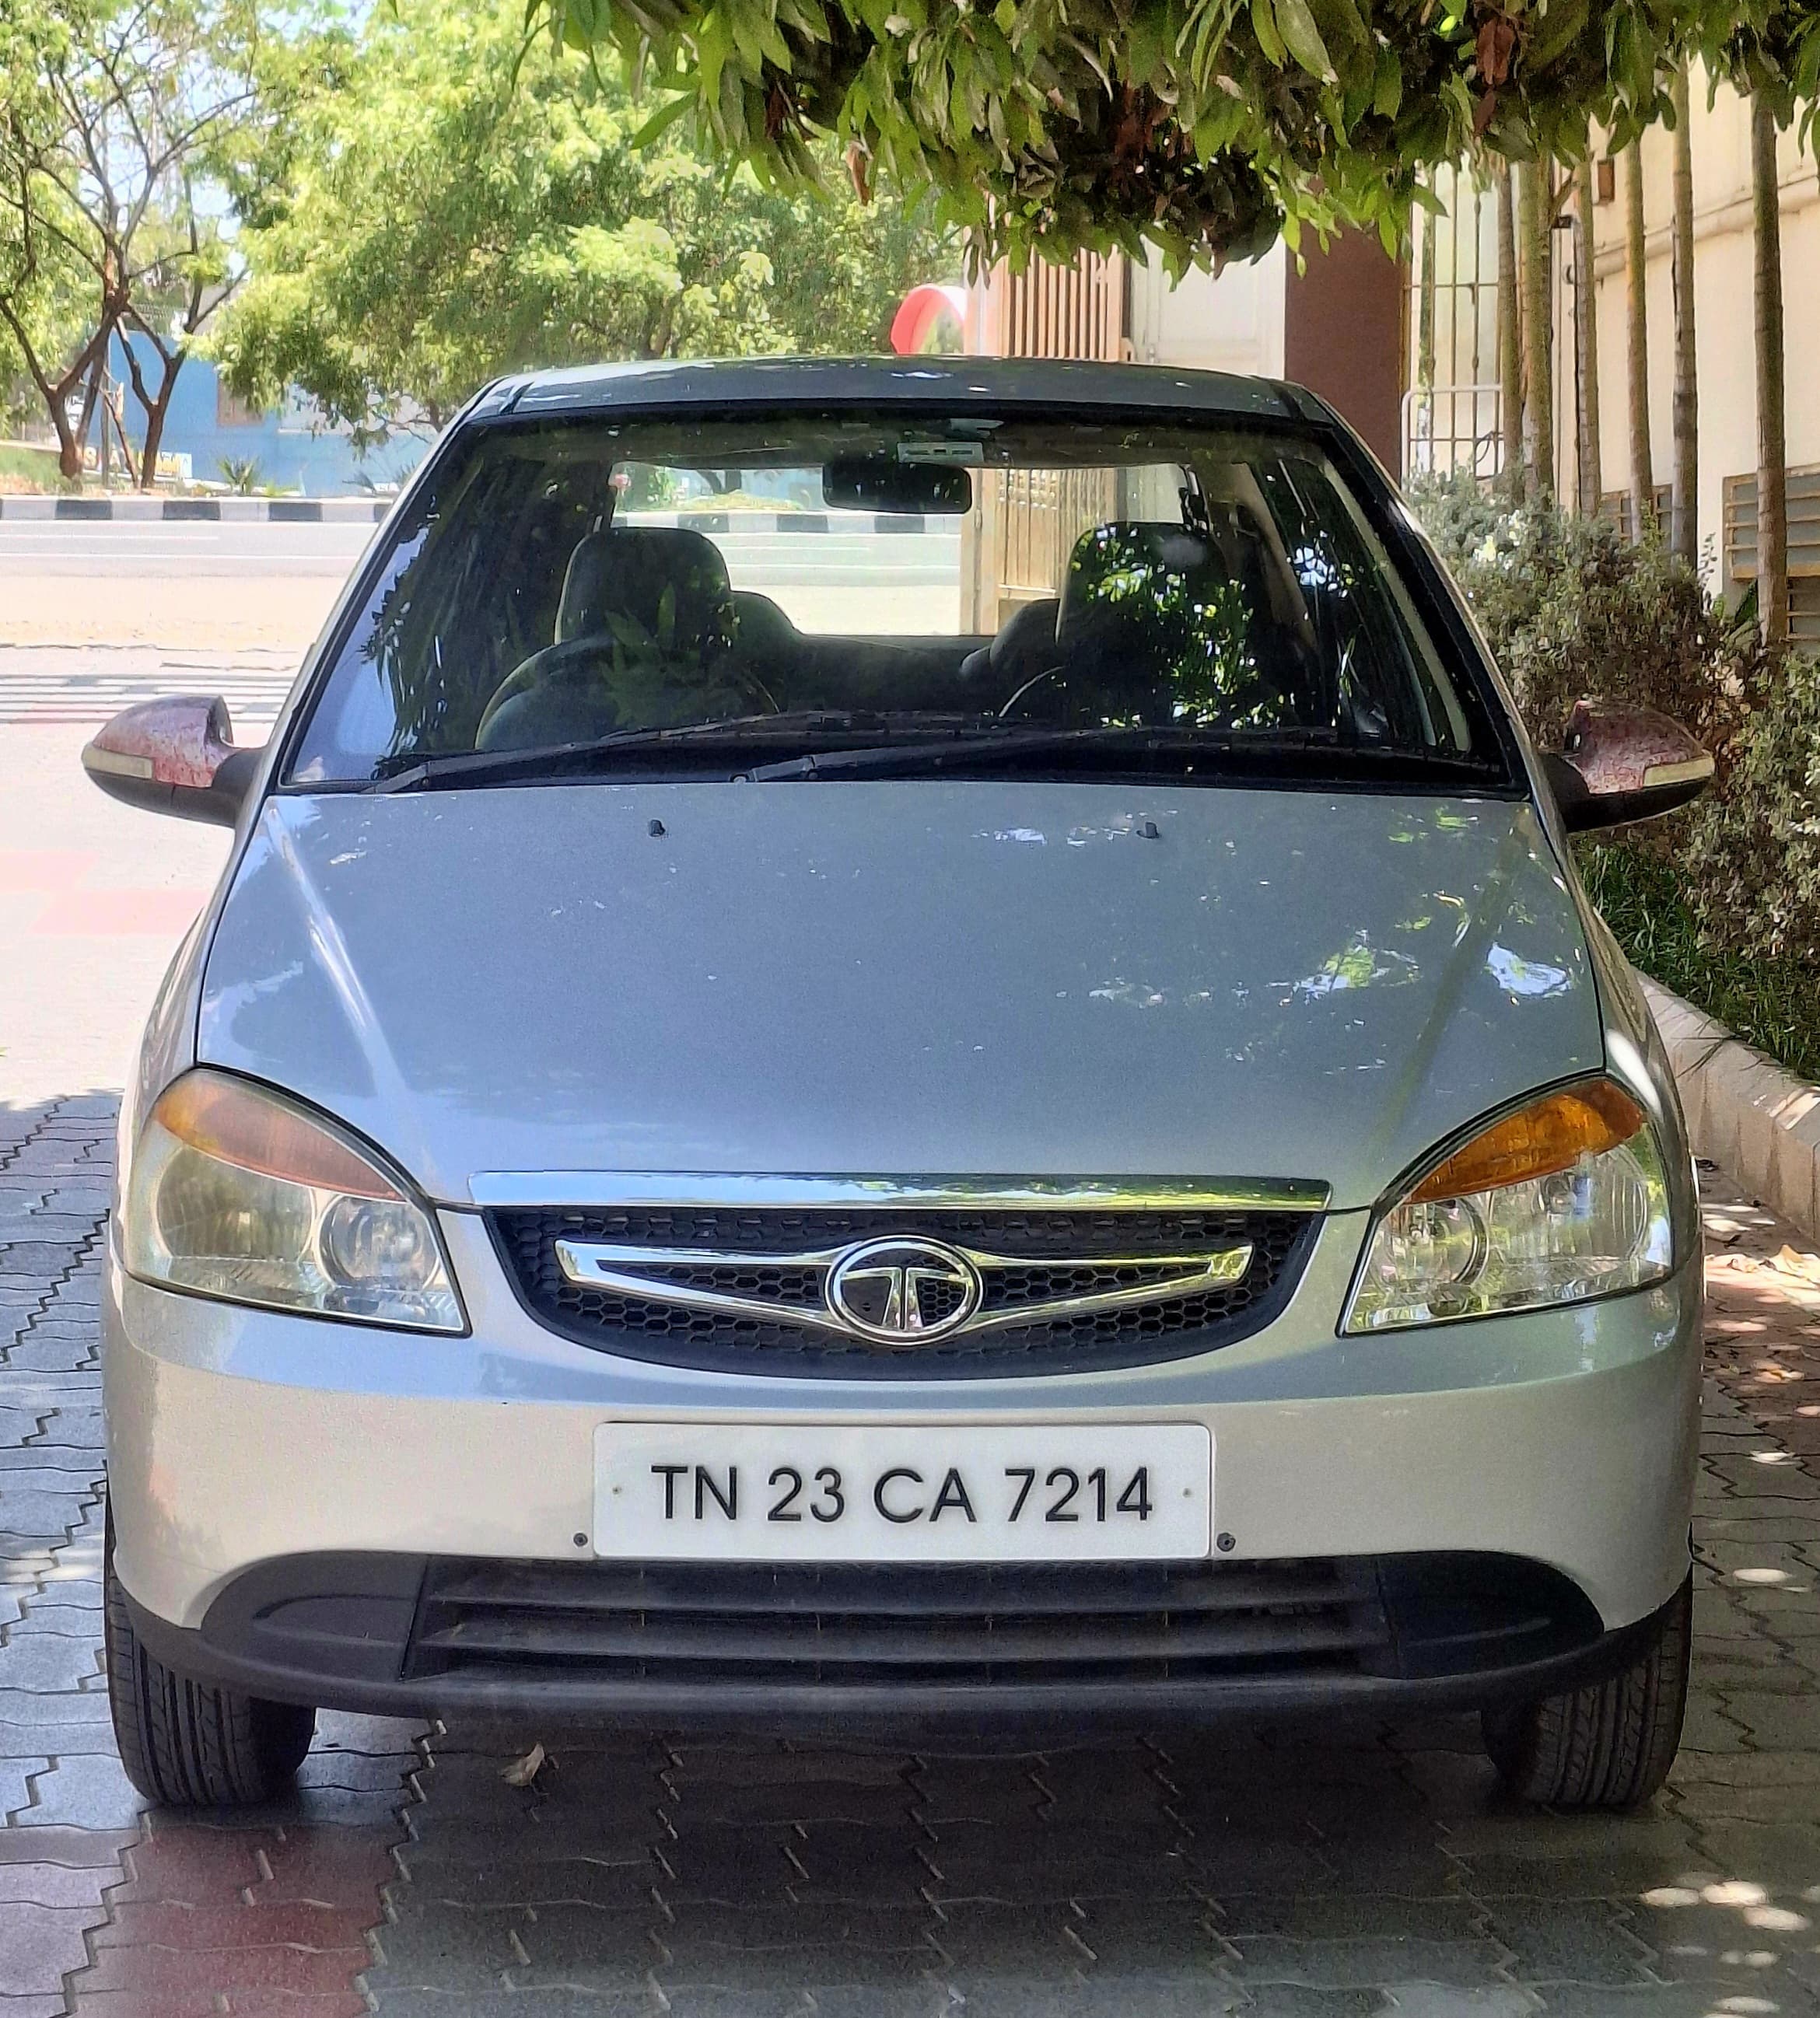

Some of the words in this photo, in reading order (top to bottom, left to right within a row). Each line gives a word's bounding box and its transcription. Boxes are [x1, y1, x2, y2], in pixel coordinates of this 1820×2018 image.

[651, 1465, 737, 1520] TN
[767, 1467, 845, 1523] 23
[873, 1467, 977, 1523] CA
[1005, 1466, 1153, 1522] 7214
